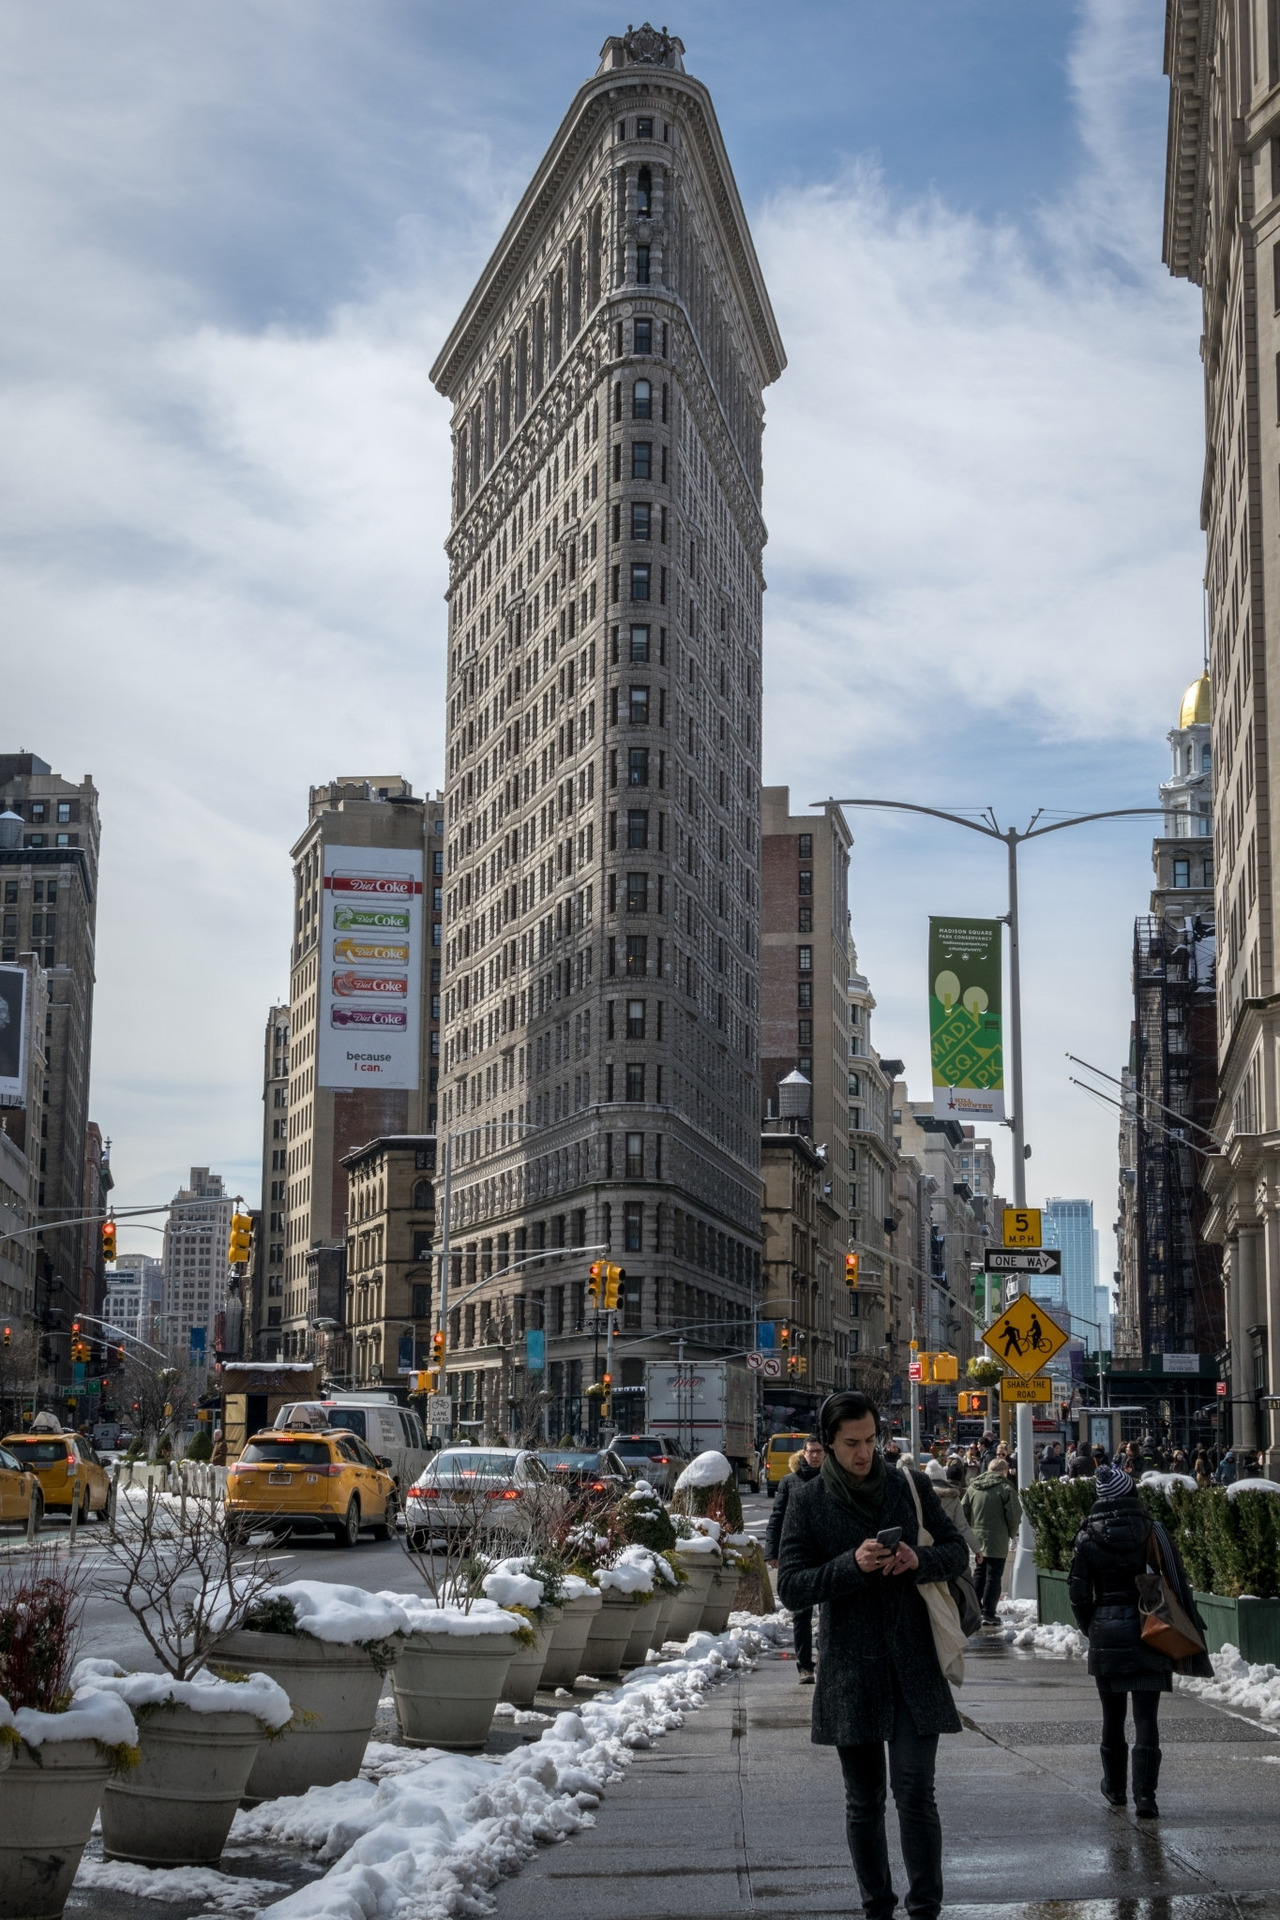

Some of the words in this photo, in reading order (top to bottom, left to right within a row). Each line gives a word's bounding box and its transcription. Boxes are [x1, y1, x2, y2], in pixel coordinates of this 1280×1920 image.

[350, 879, 375, 891] Diet
[376, 880, 409, 893] Coke
[355, 915, 374, 923] Diet
[374, 914, 404, 926] Coke
[355, 948, 374, 956] Diet
[374, 947, 404, 959] Coke
[354, 980, 372, 988] Diet
[372, 980, 402, 991] Coke
[352, 1013, 371, 1022] Diet
[372, 1013, 402, 1024] Coke
[932, 1022, 971, 1062] MAD.
[346, 1051, 392, 1061] because
[354, 1062, 358, 1071] I
[361, 1064, 383, 1072] can.
[946, 1054, 977, 1080] SQ.
[976, 1058, 1003, 1086] PK
[1016, 1214, 1028, 1232] 5
[995, 1256, 1017, 1266] ONE
[1027, 1257, 1049, 1267] WAY
